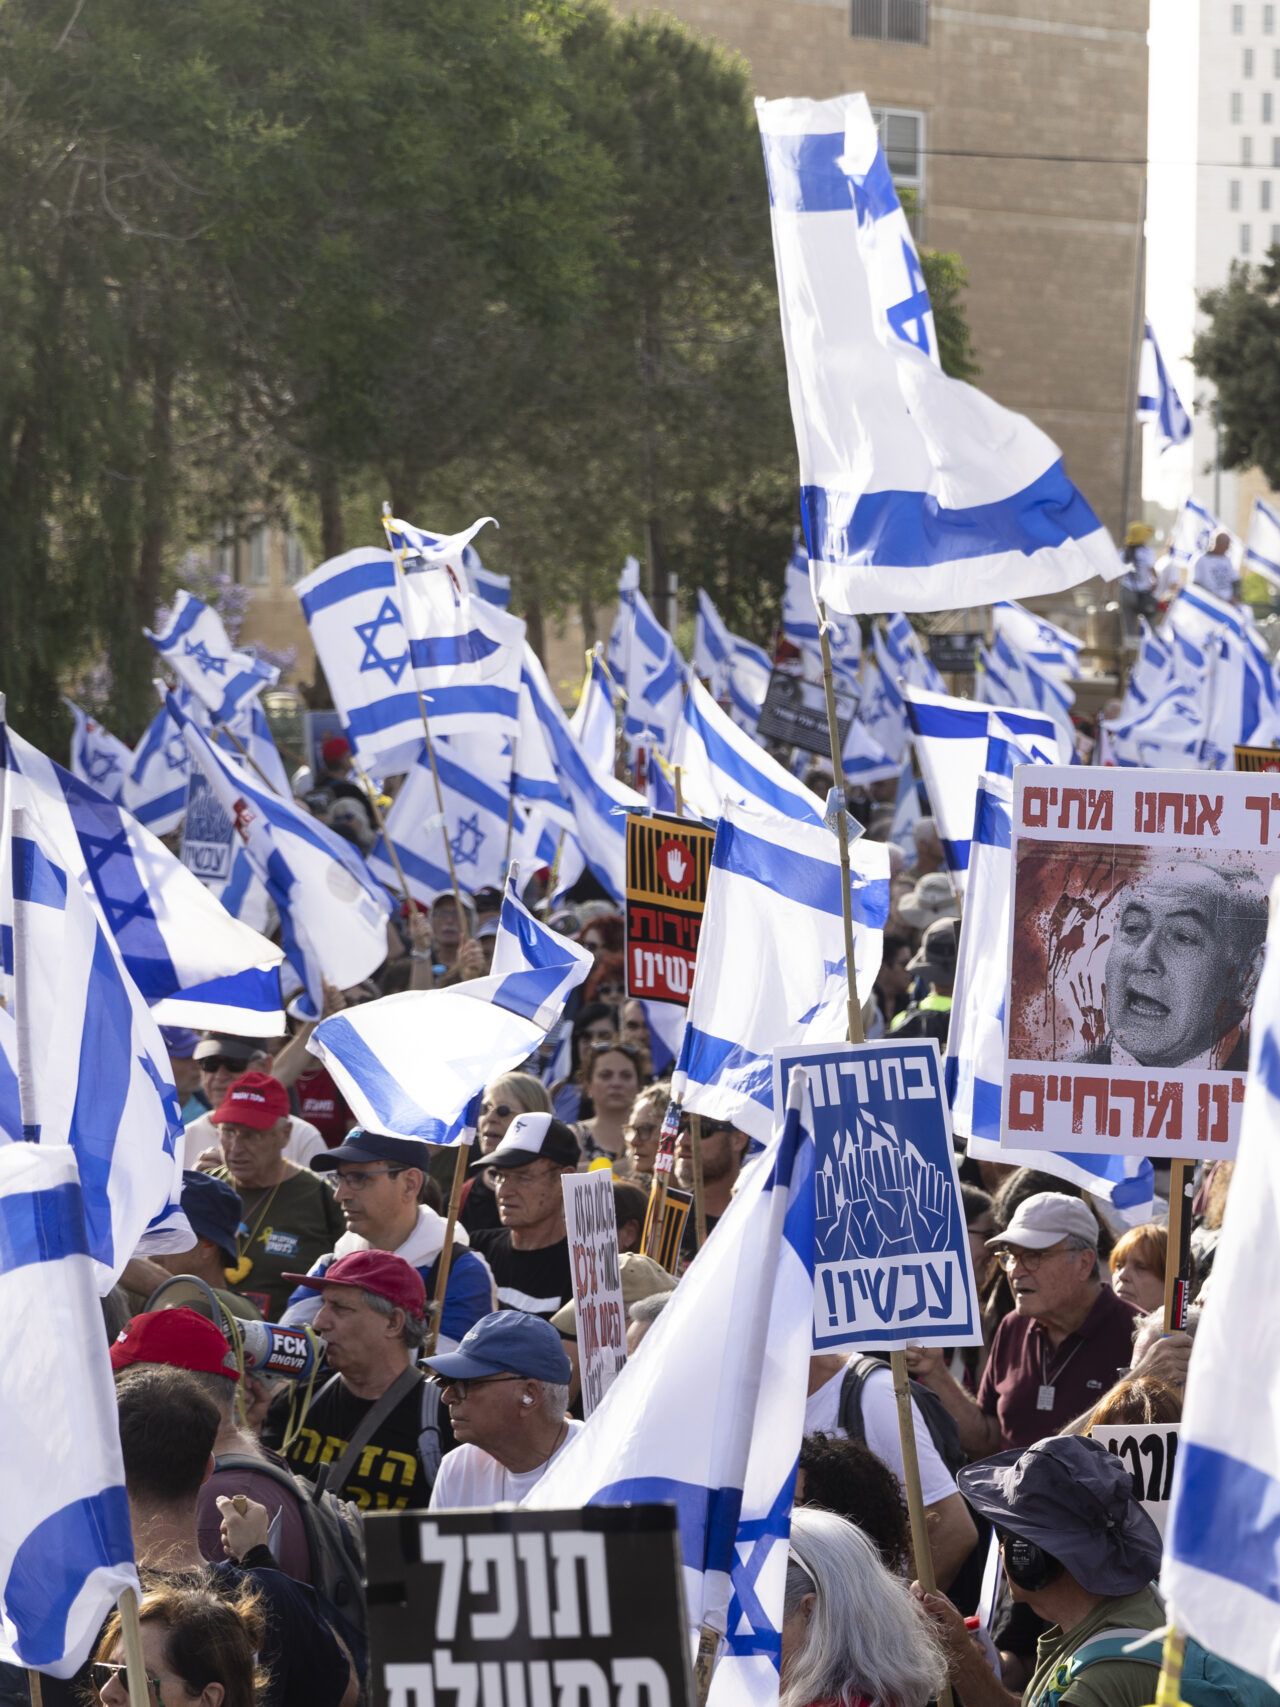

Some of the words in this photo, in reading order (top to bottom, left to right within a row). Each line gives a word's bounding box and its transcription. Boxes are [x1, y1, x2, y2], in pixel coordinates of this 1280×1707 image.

[1022, 786, 1113, 831] מתים
[1135, 791, 1224, 836] אנחנו
[630, 906, 702, 949] חירות
[1008, 1073, 1183, 1140] מהחיים
[821, 1261, 953, 1327] עכשיו!
[269, 1353, 305, 1368] BNGVR
[273, 1334, 307, 1357] FCK
[420, 1521, 611, 1641] תופל
